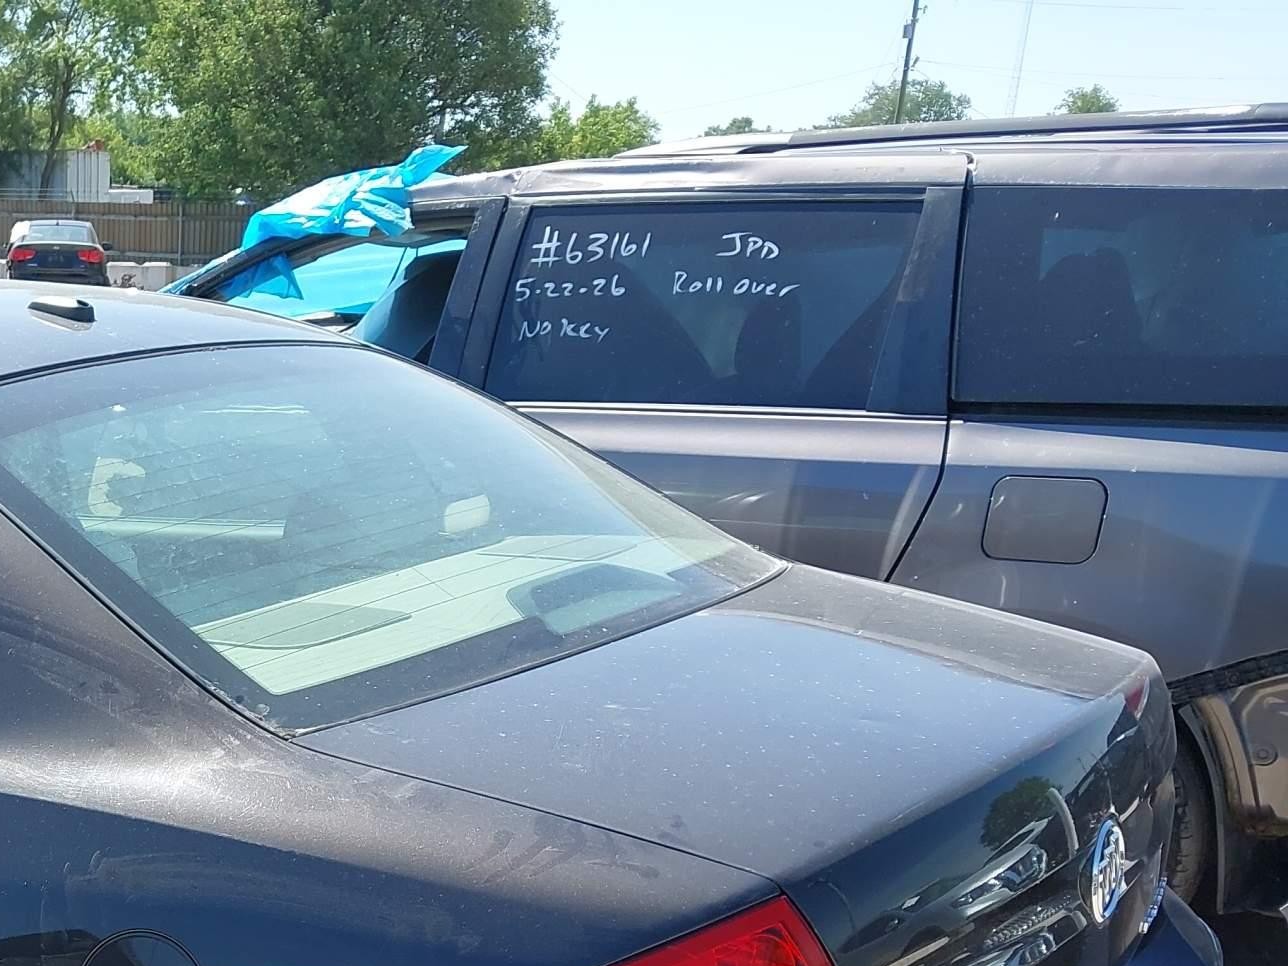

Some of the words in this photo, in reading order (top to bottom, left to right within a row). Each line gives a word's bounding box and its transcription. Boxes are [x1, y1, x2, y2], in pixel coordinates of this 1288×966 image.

[530, 225, 652, 268] #63161
[715, 231, 779, 259] JPD
[672, 270, 723, 295] Roll
